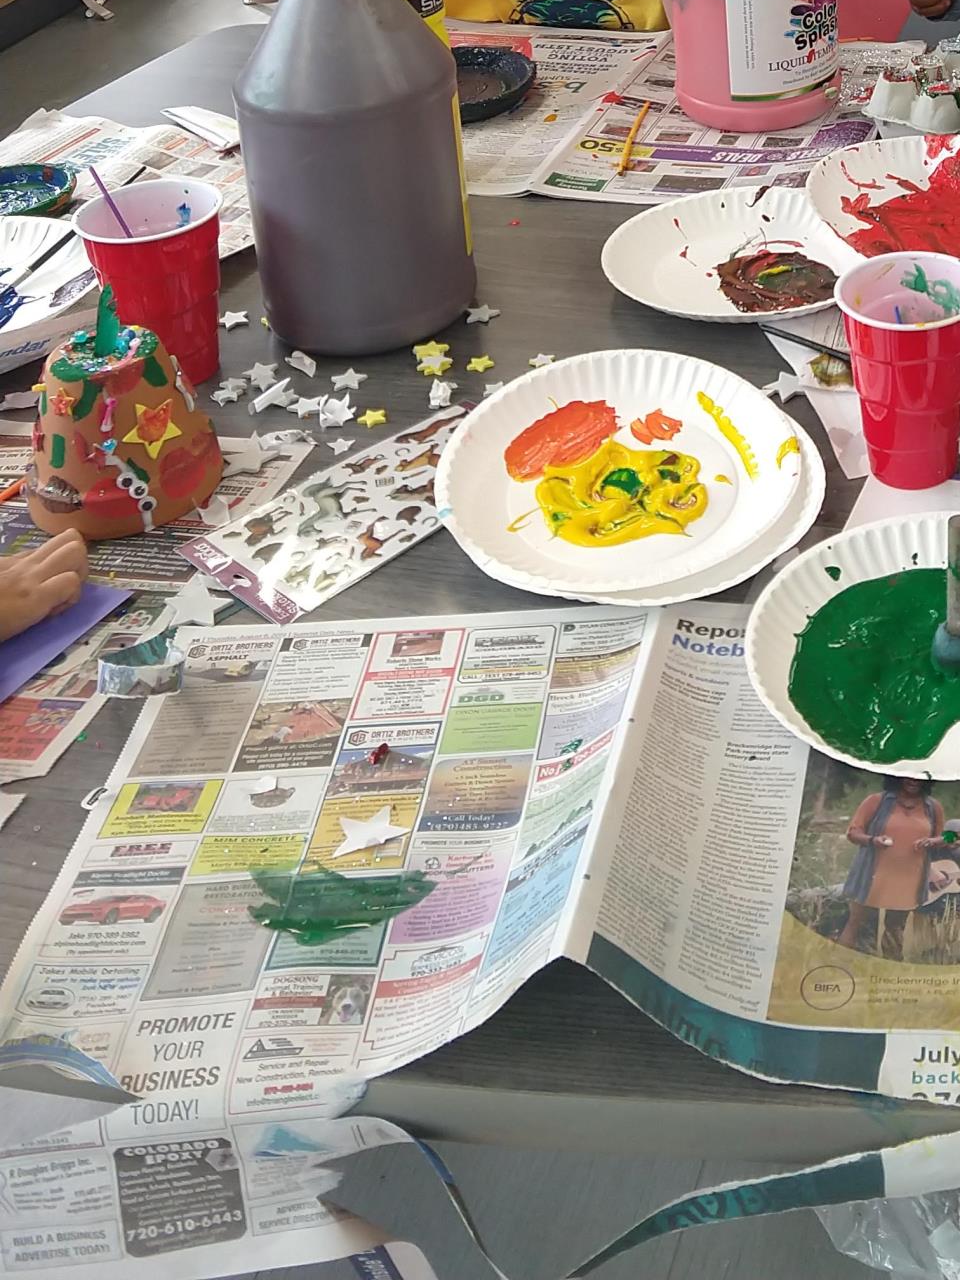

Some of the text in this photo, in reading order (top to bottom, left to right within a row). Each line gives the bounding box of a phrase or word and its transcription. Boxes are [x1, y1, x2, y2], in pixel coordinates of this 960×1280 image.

[802, 2, 837, 30] Color
[793, 18, 837, 51] Splas
[547, 52, 608, 62] VOTING
[575, 45, 639, 55] AUGUST
[536, 80, 587, 94] bes
[711, 151, 764, 163] DEALS
[236, 642, 273, 650] BROTHERS
[206, 654, 249, 662] ASPHALT
[370, 728, 435, 739] ORTIZ BROTHERS
[272, 975, 319, 984] DOGSONG
[870, 974, 951, 987] Breckenridge
[814, 983, 841, 993] BIFA
[138, 1011, 237, 1036] PROMOTE
[153, 1040, 204, 1062] YOUR
[120, 1065, 221, 1094] BUSINESS
[130, 1098, 199, 1125] TODAY!
[123, 1139, 219, 1157] COLORADO
[145, 1150, 204, 1166] EPOXY
[13, 1234, 44, 1246] BUILD
[56, 1229, 107, 1242] BUSINESS
[14, 1246, 71, 1263] ADVERTISE
